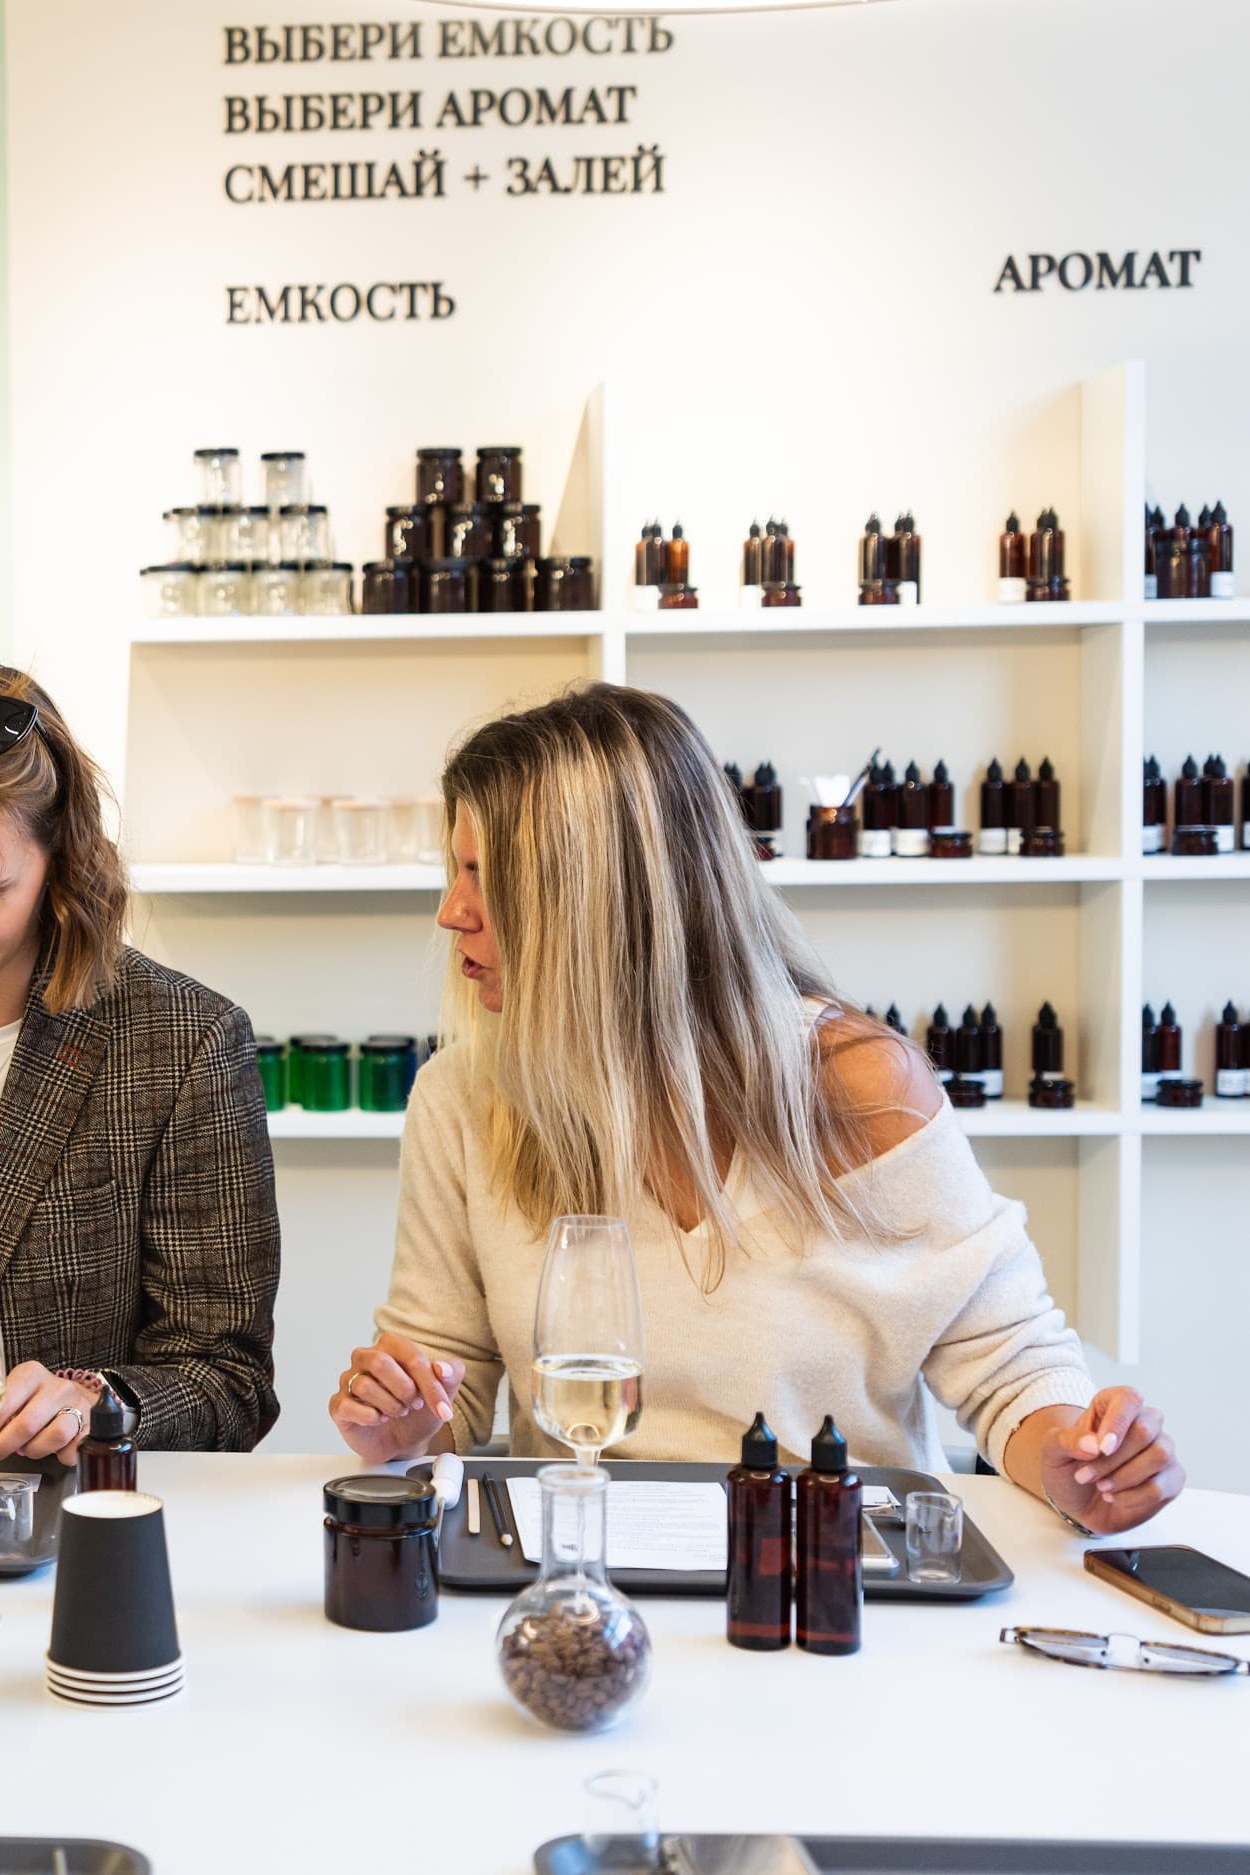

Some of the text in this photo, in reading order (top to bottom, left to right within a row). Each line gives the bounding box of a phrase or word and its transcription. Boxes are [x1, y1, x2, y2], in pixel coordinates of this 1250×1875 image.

[223, 17, 675, 65] ВЫБЕРИ ЕМКОСТЬ
[223, 85, 638, 135] ВЫБЕРИ АРОМАТ
[223, 144, 666, 204] СМЕШАЙ + ЗАЛЕЙ
[993, 249, 1202, 294] АРОМАТ
[225, 281, 457, 324] ЕМКОСТЬ
